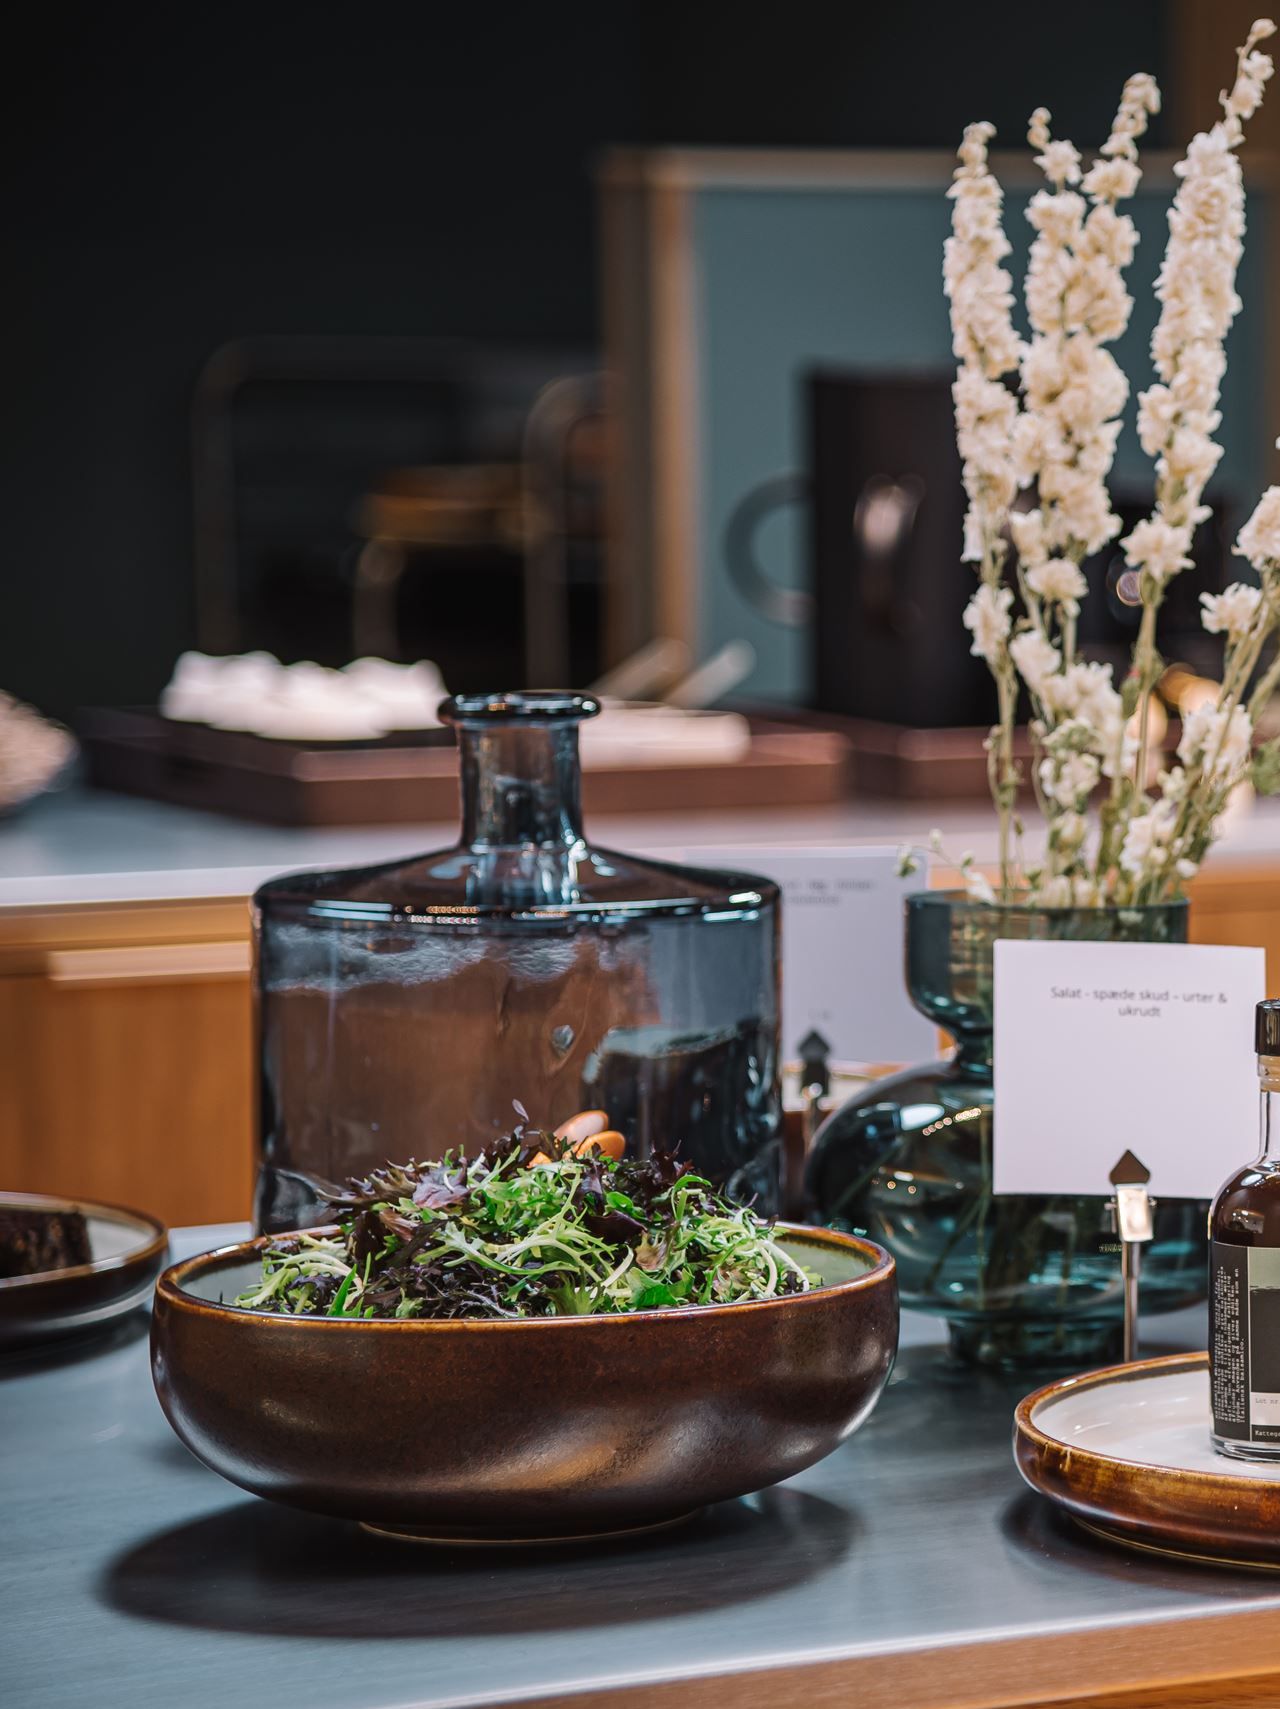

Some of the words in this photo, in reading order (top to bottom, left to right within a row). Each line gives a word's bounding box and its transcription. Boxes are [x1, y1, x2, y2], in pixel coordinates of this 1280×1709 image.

[1050, 986, 1082, 999] Salat
[1093, 988, 1135, 1002] spæde
[1139, 989, 1169, 1001] skud
[1182, 991, 1213, 1003] urter
[1217, 992, 1228, 1003] &
[1118, 1004, 1161, 1017] ukrudt
